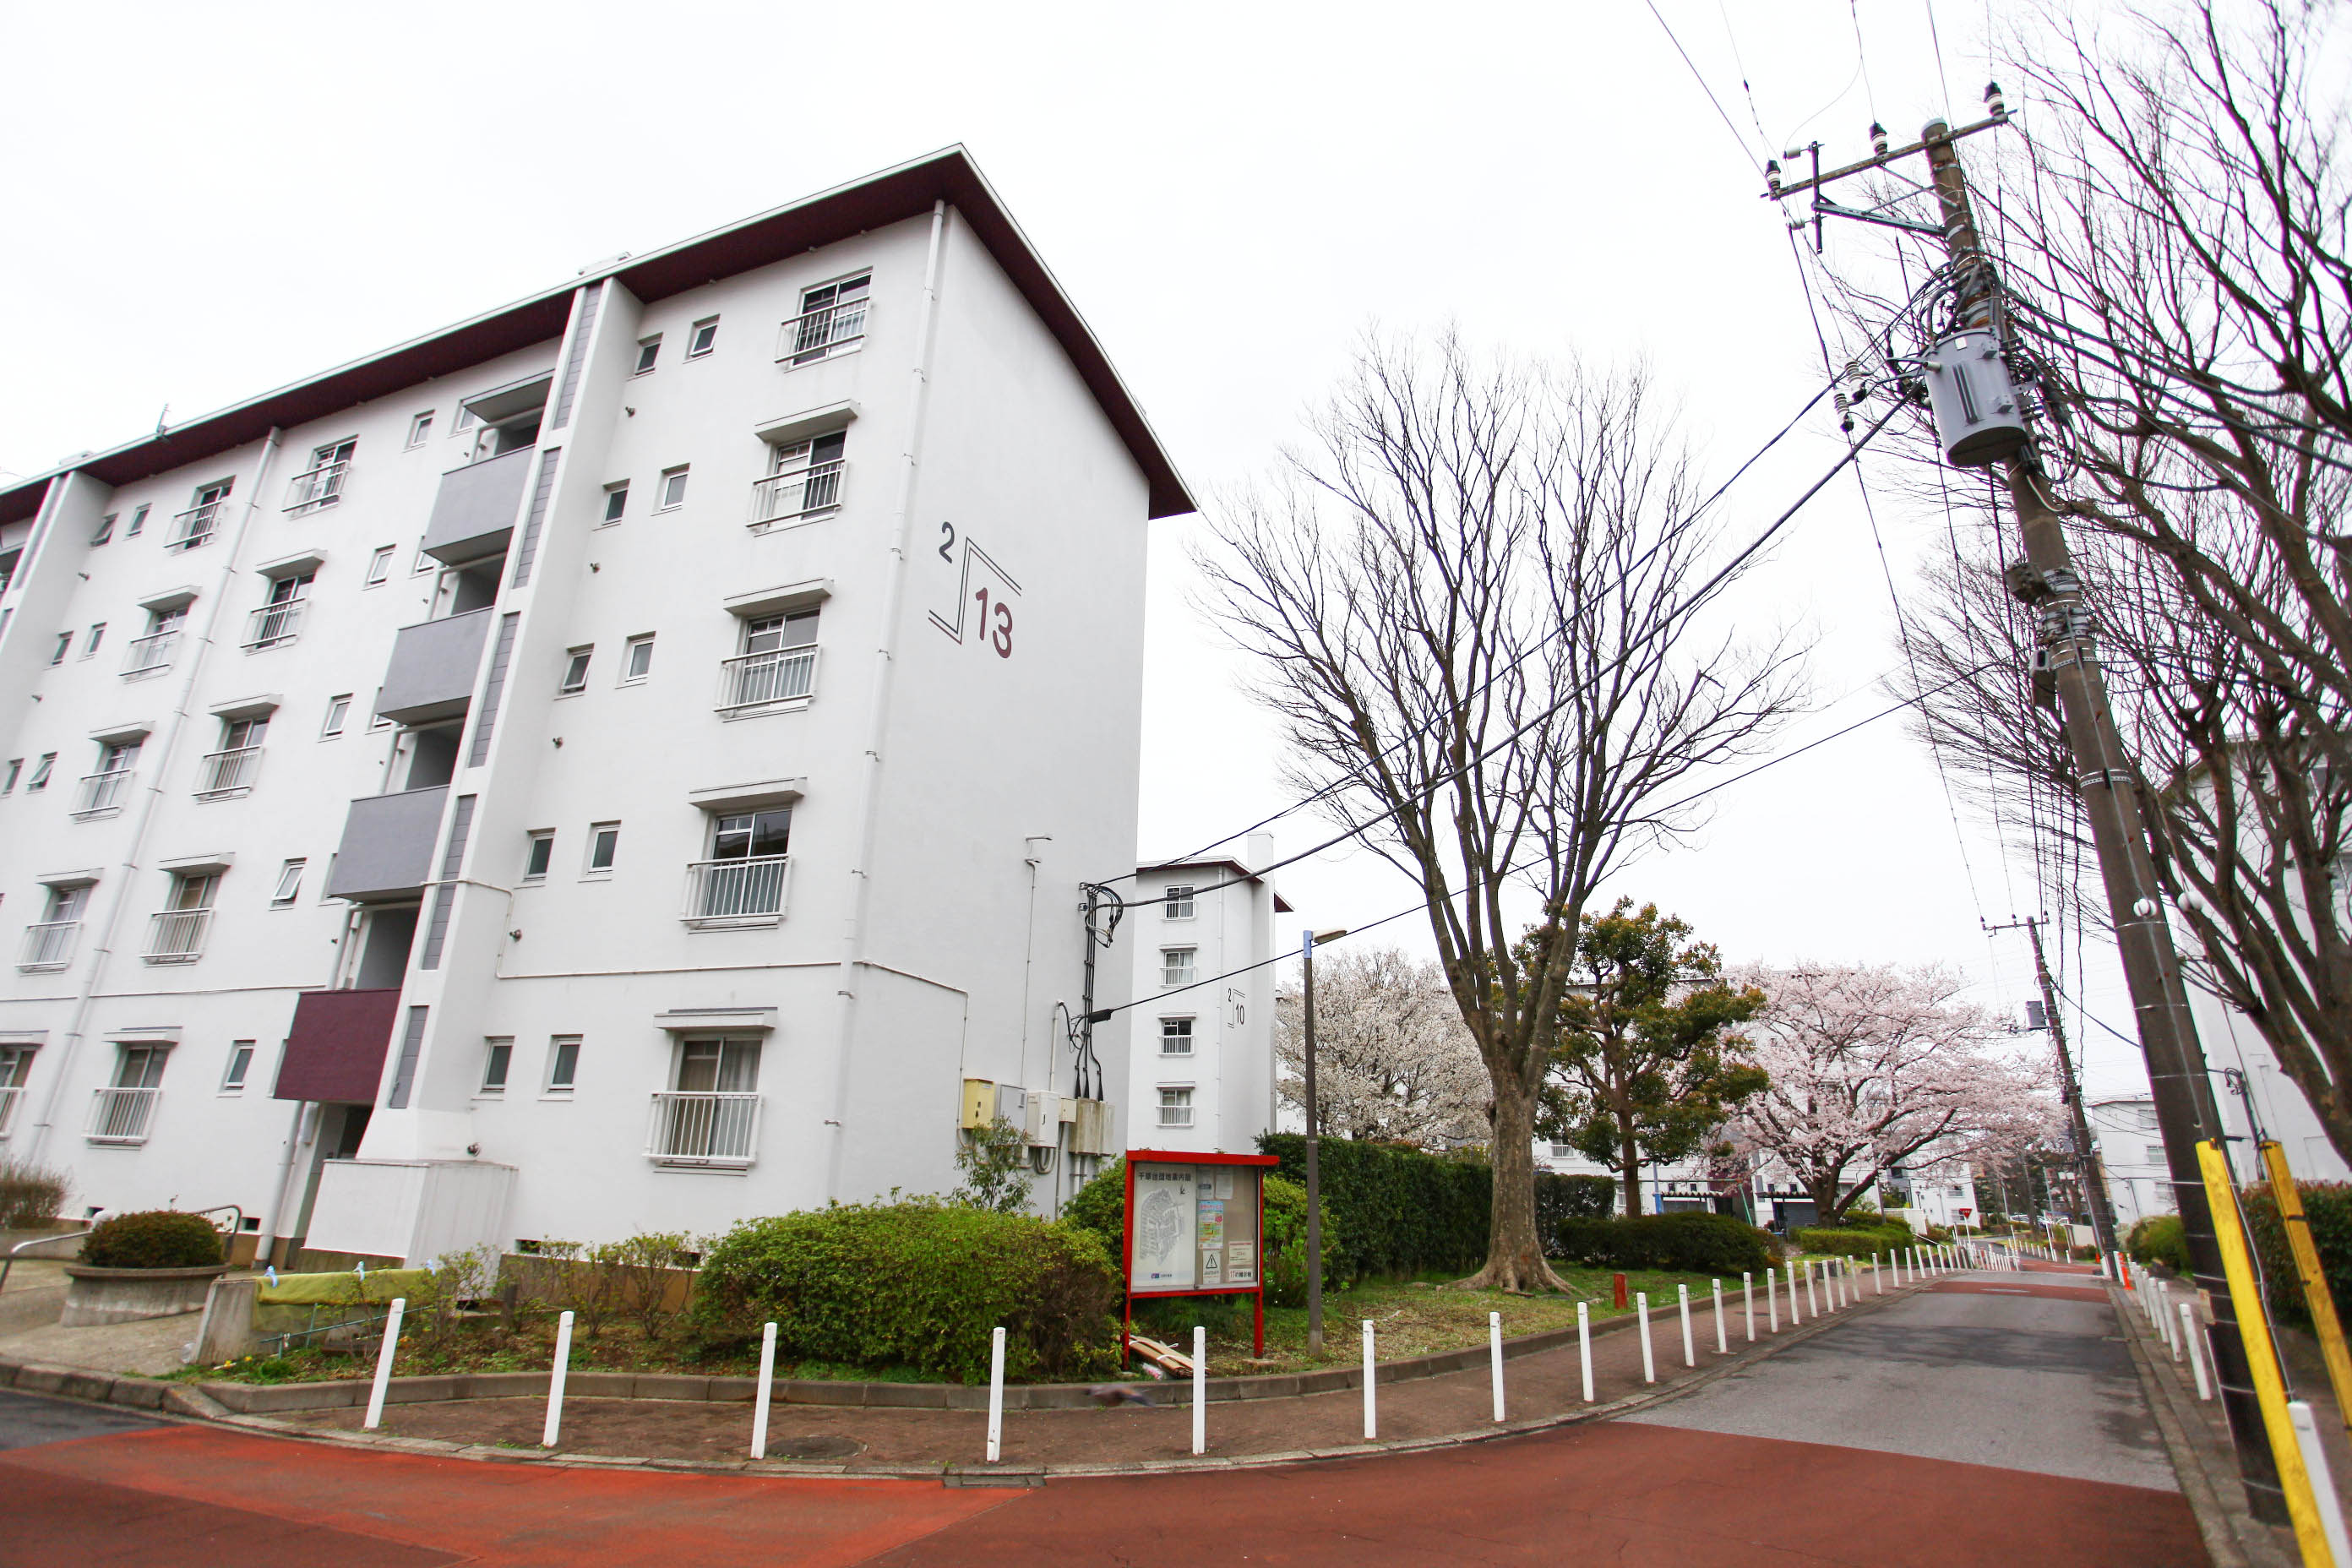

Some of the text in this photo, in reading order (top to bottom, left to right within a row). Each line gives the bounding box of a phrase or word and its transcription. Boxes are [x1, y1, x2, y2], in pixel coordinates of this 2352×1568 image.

[939, 521, 955, 564] 2
[975, 587, 1013, 659] 13
[1228, 988, 1232, 1003] 2
[1235, 1003, 1245, 1025] 10
